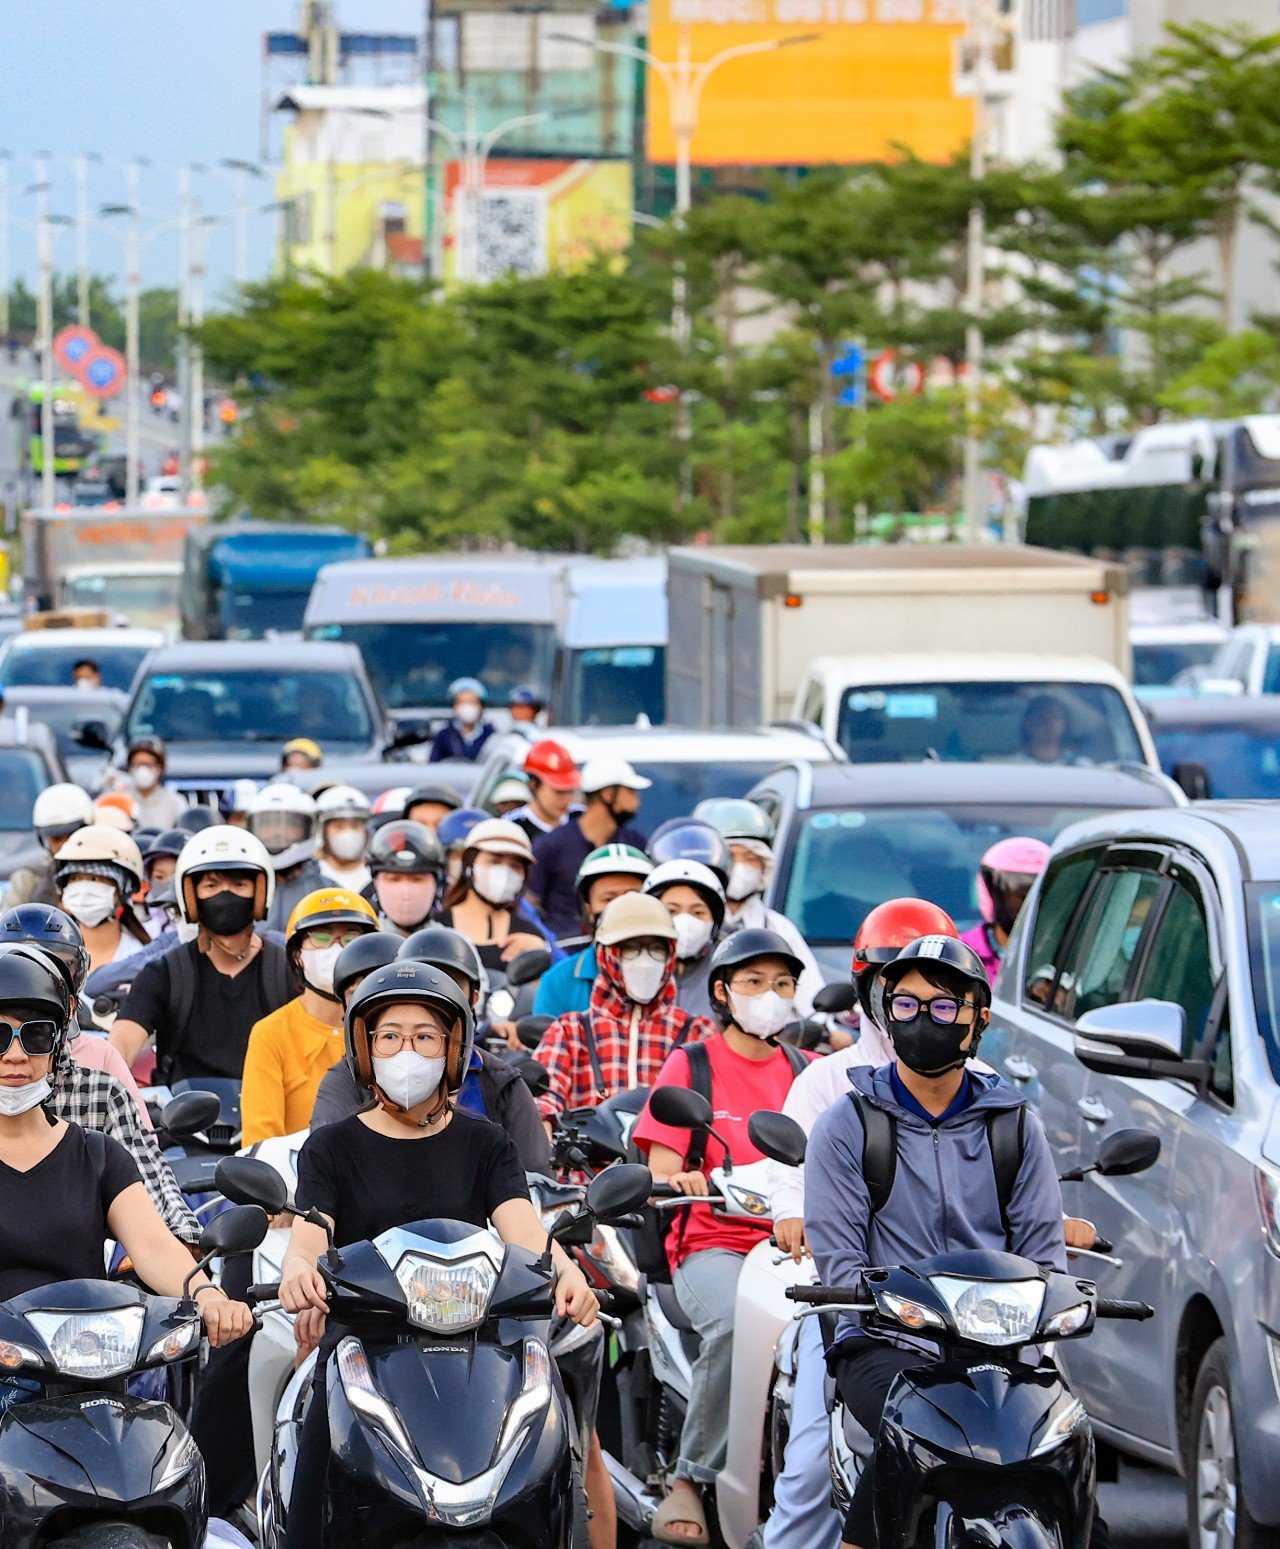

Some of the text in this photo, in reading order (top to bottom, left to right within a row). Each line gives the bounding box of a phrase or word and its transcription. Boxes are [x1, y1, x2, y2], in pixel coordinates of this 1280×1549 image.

[422, 1346, 470, 1354] HONDA
[966, 1363, 1013, 1376] HONDA
[79, 1398, 126, 1411] HONDA
